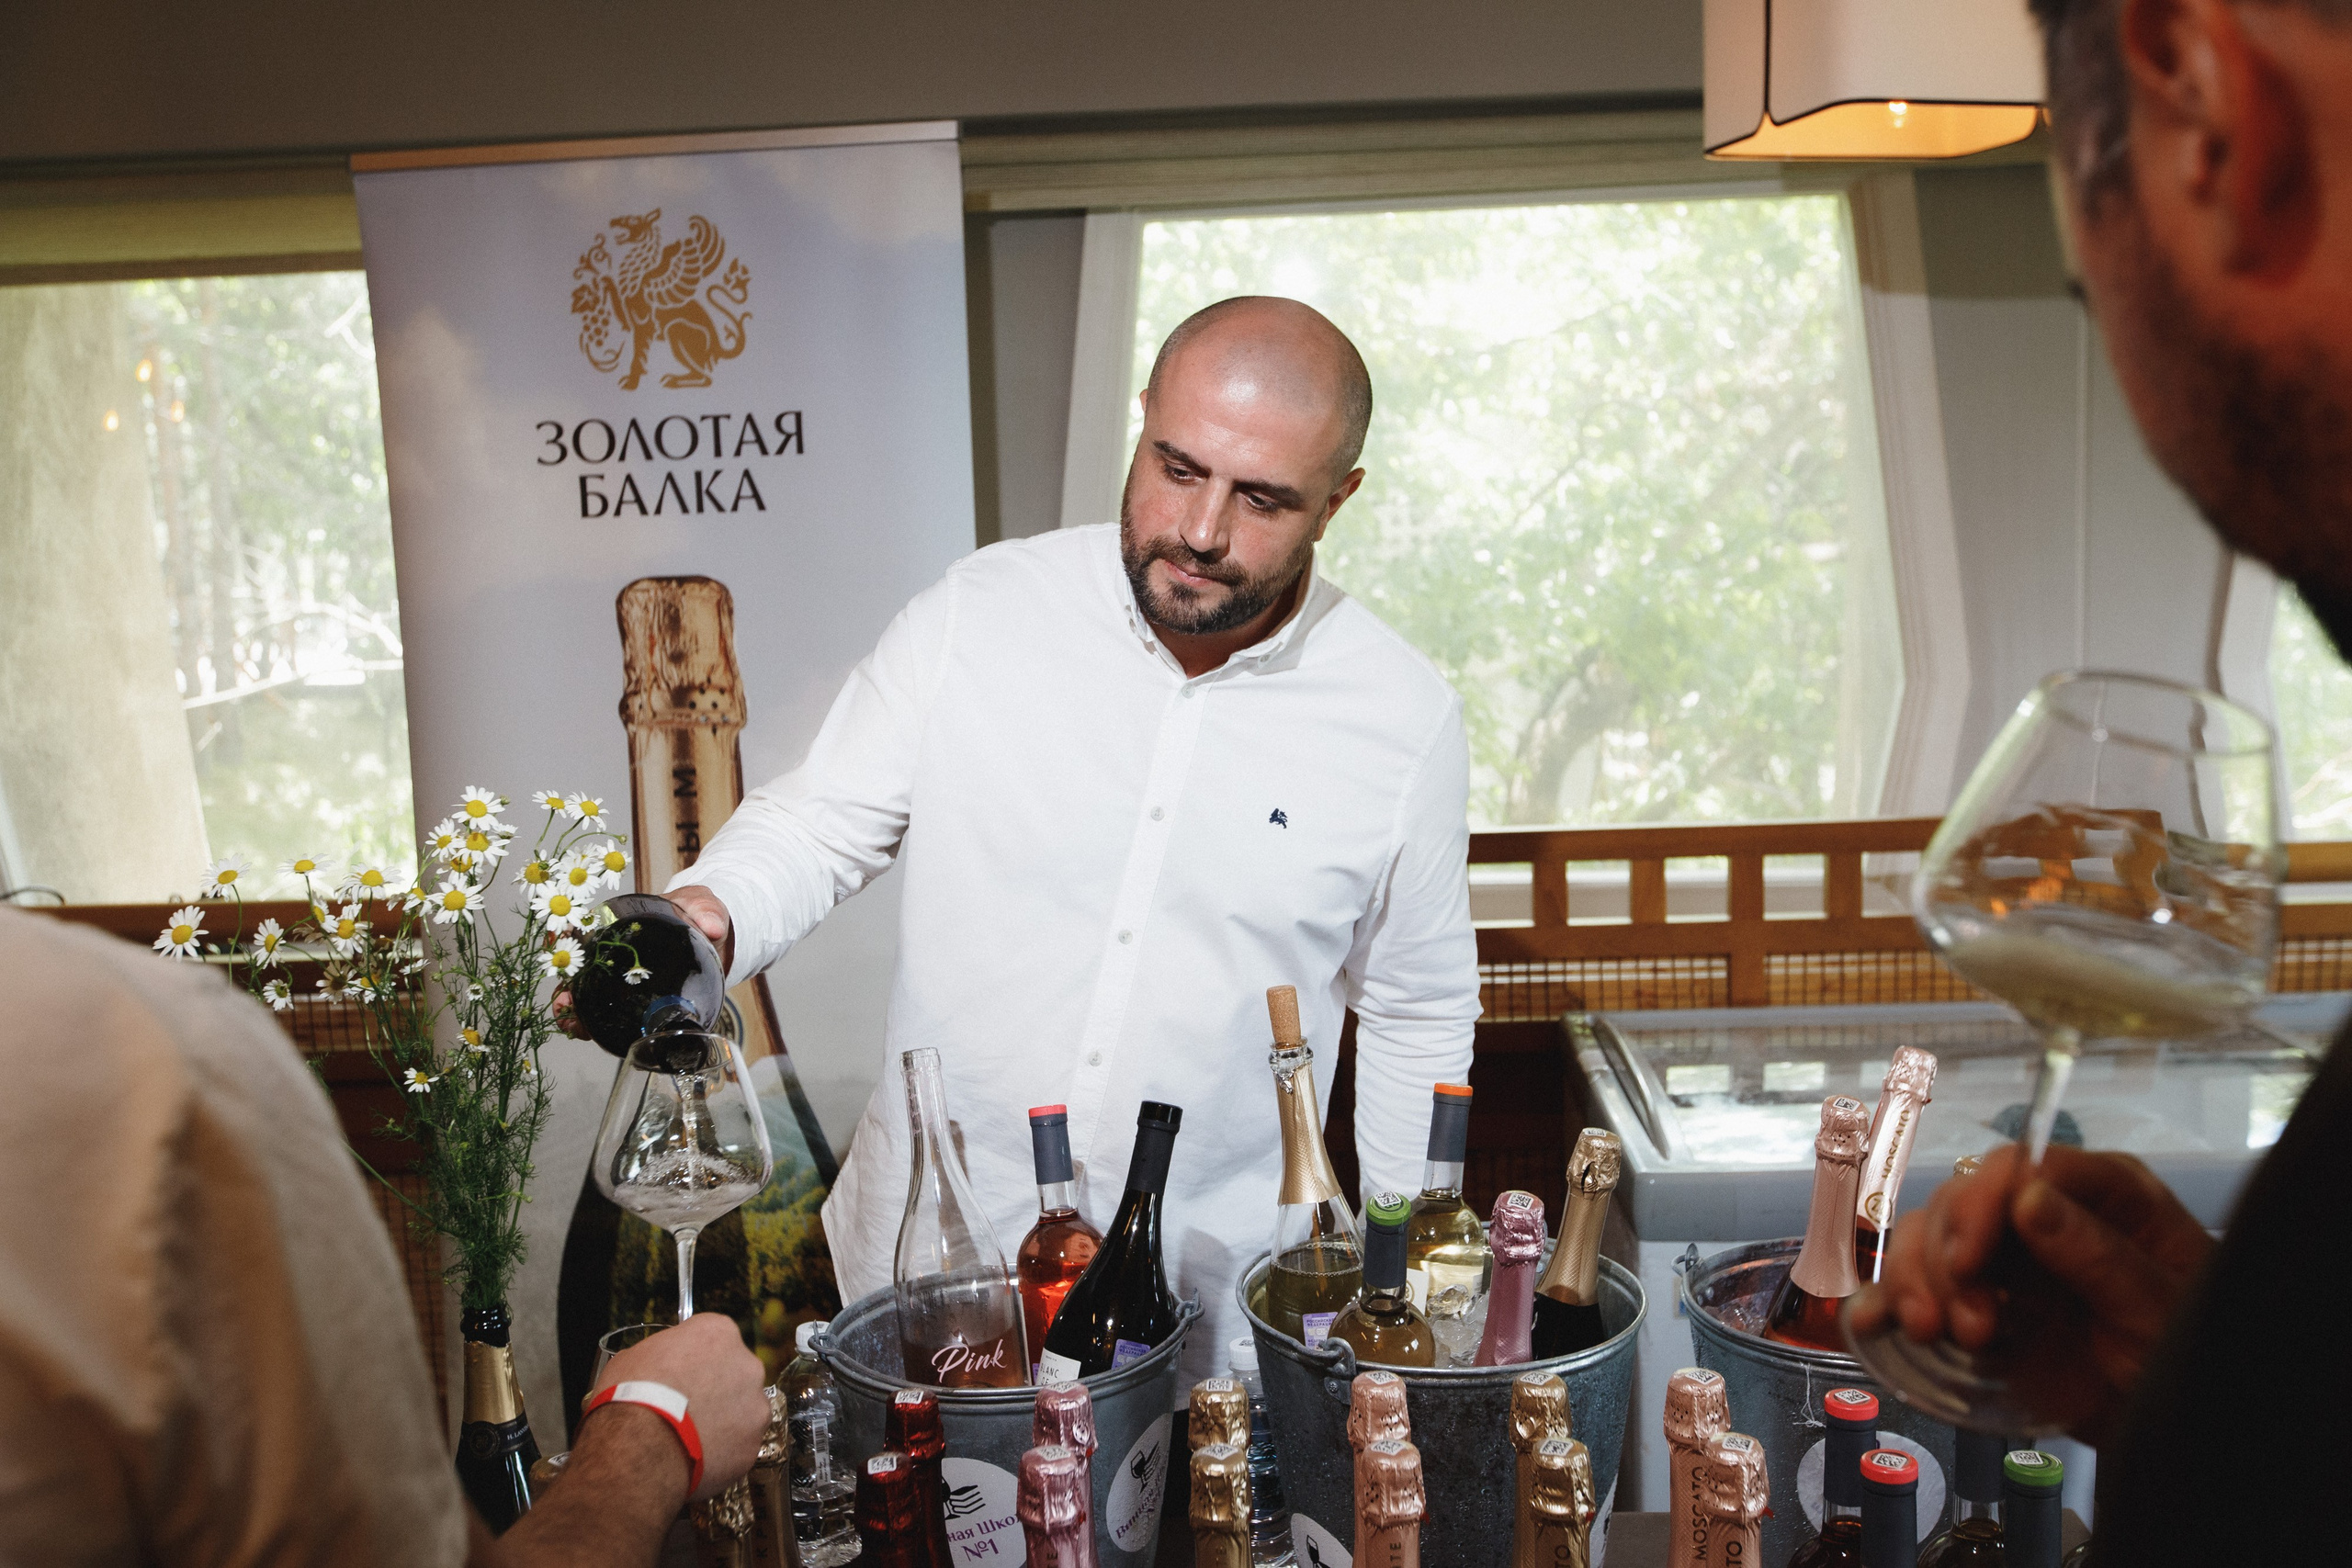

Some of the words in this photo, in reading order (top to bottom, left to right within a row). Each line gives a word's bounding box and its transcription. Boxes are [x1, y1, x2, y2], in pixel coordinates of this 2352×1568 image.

[536, 411, 805, 467] ЗОЛОТАЯ
[578, 468, 768, 519] БАЛКА
[672, 767, 701, 853] ЫМ
[931, 1338, 1008, 1383] Pink
[976, 1514, 1019, 1535] Шко
[1691, 1466, 1708, 1561] MOSCATO
[961, 1538, 1000, 1562] №1
